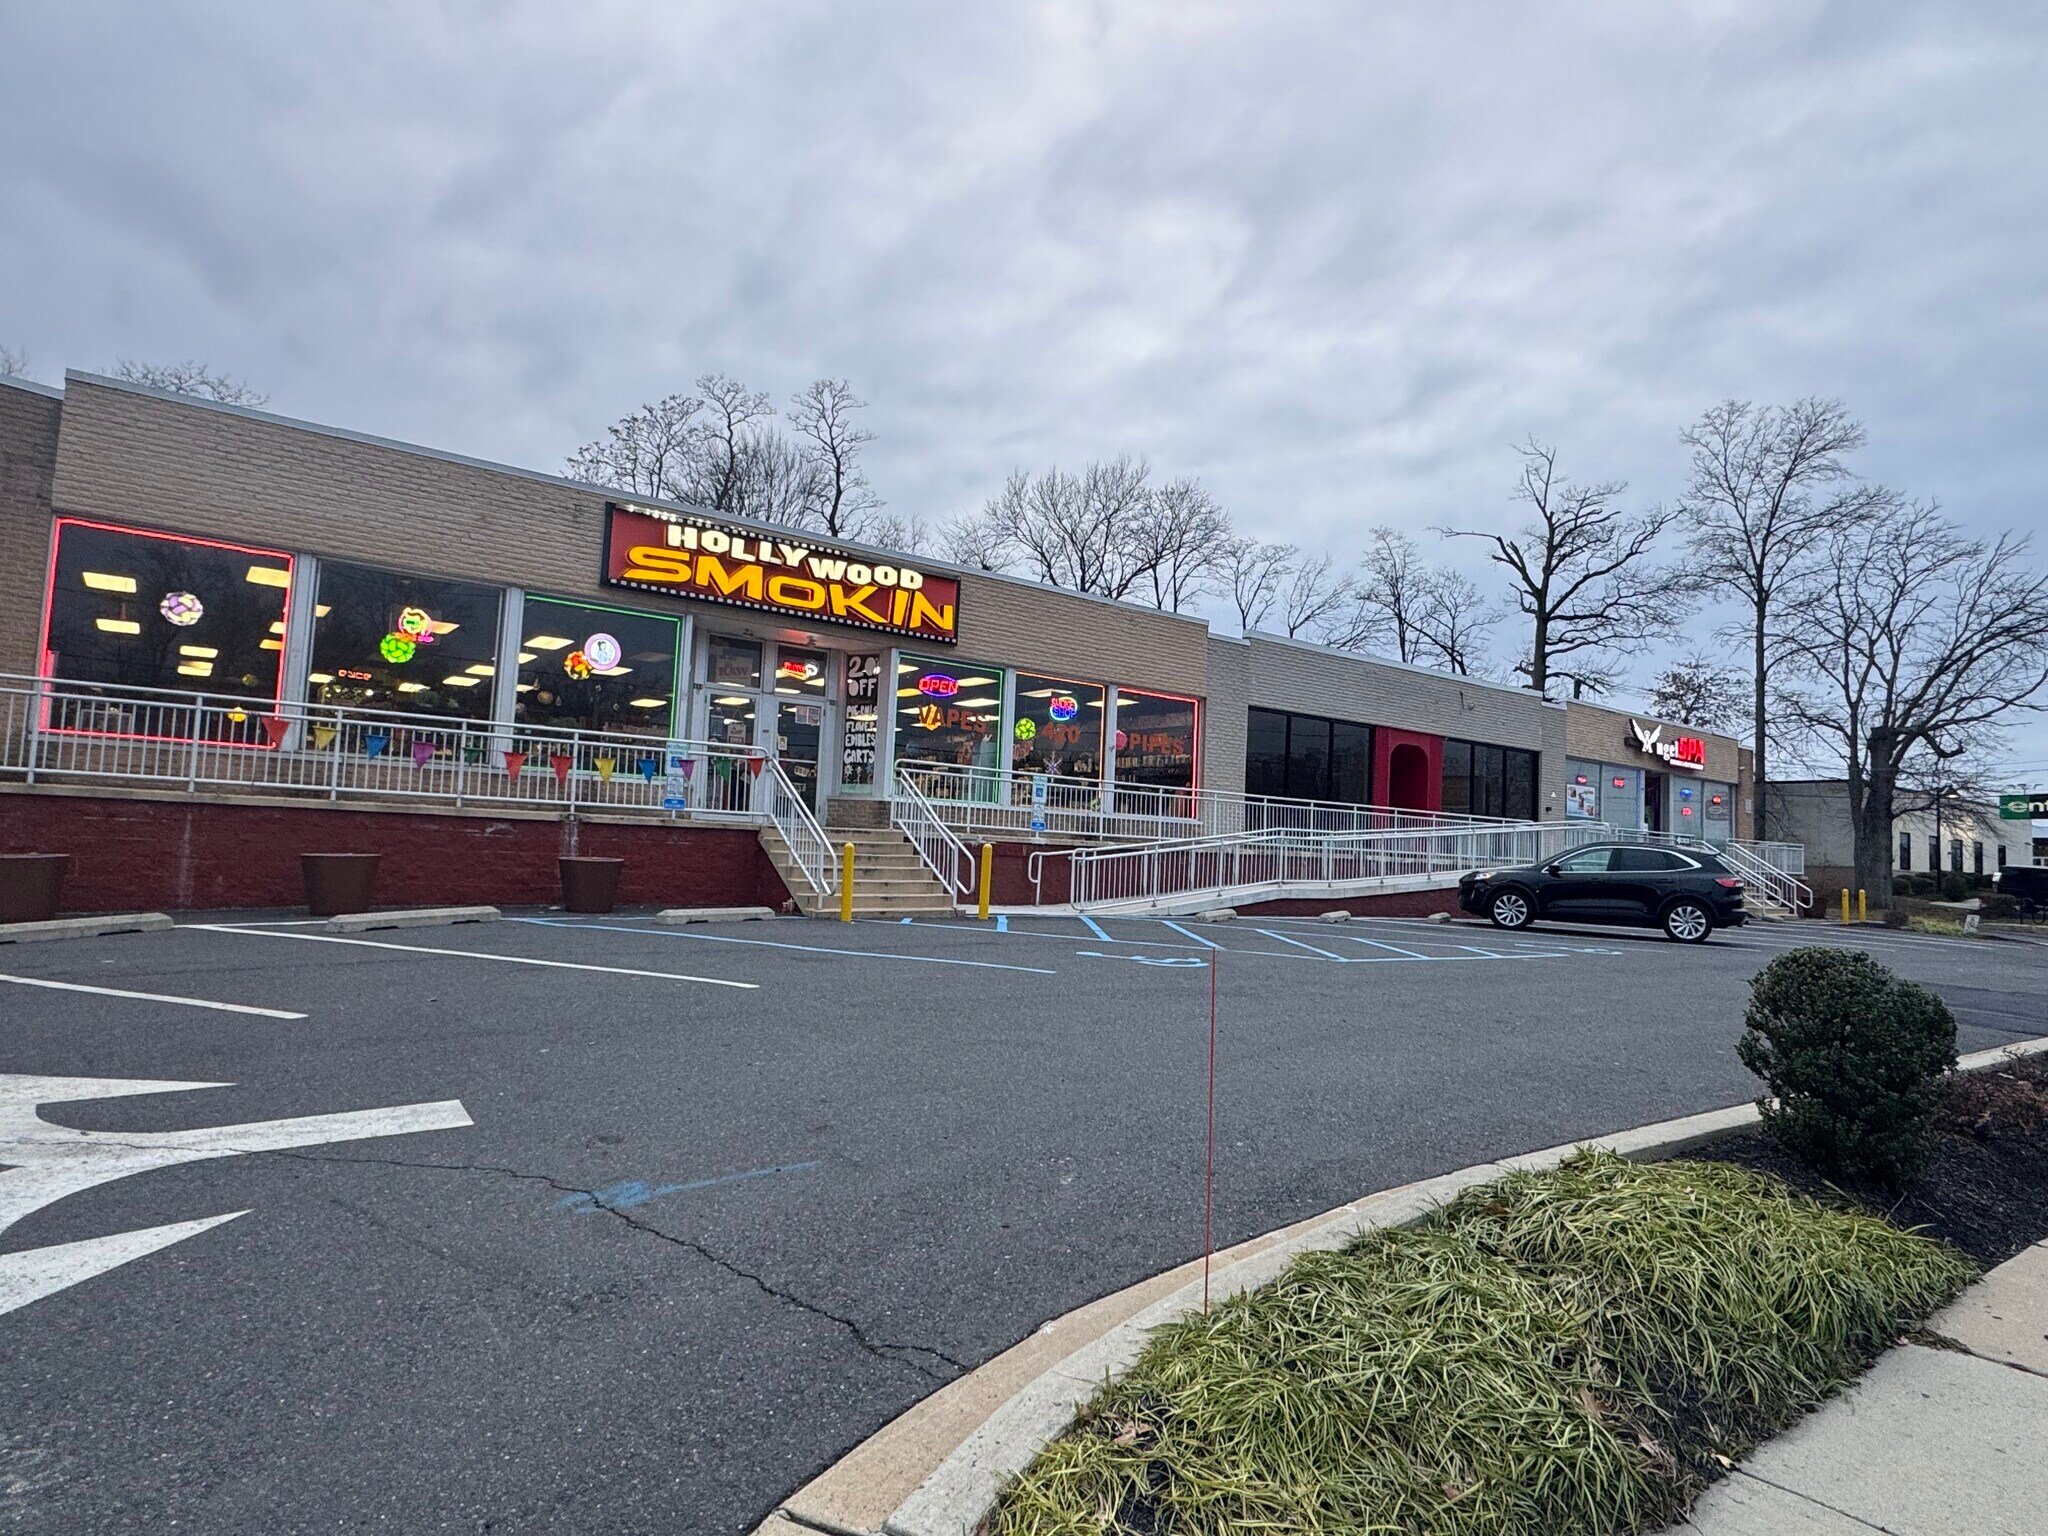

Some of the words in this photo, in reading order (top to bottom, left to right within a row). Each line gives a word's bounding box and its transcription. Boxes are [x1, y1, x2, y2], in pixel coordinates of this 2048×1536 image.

[667, 524, 923, 590] HOLLYWOOD
[622, 546, 954, 630] SMOKIN
[848, 678, 877, 697] OFF
[919, 677, 959, 694] OPEN
[1051, 697, 1074, 709] SMOKE
[1054, 706, 1077, 718] SHOP
[917, 704, 986, 733] VAPES
[845, 733, 876, 747] EDIBLES
[1129, 732, 1184, 755] PIPES
[844, 748, 875, 764] CARTS
[1678, 737, 1705, 764] SPA
